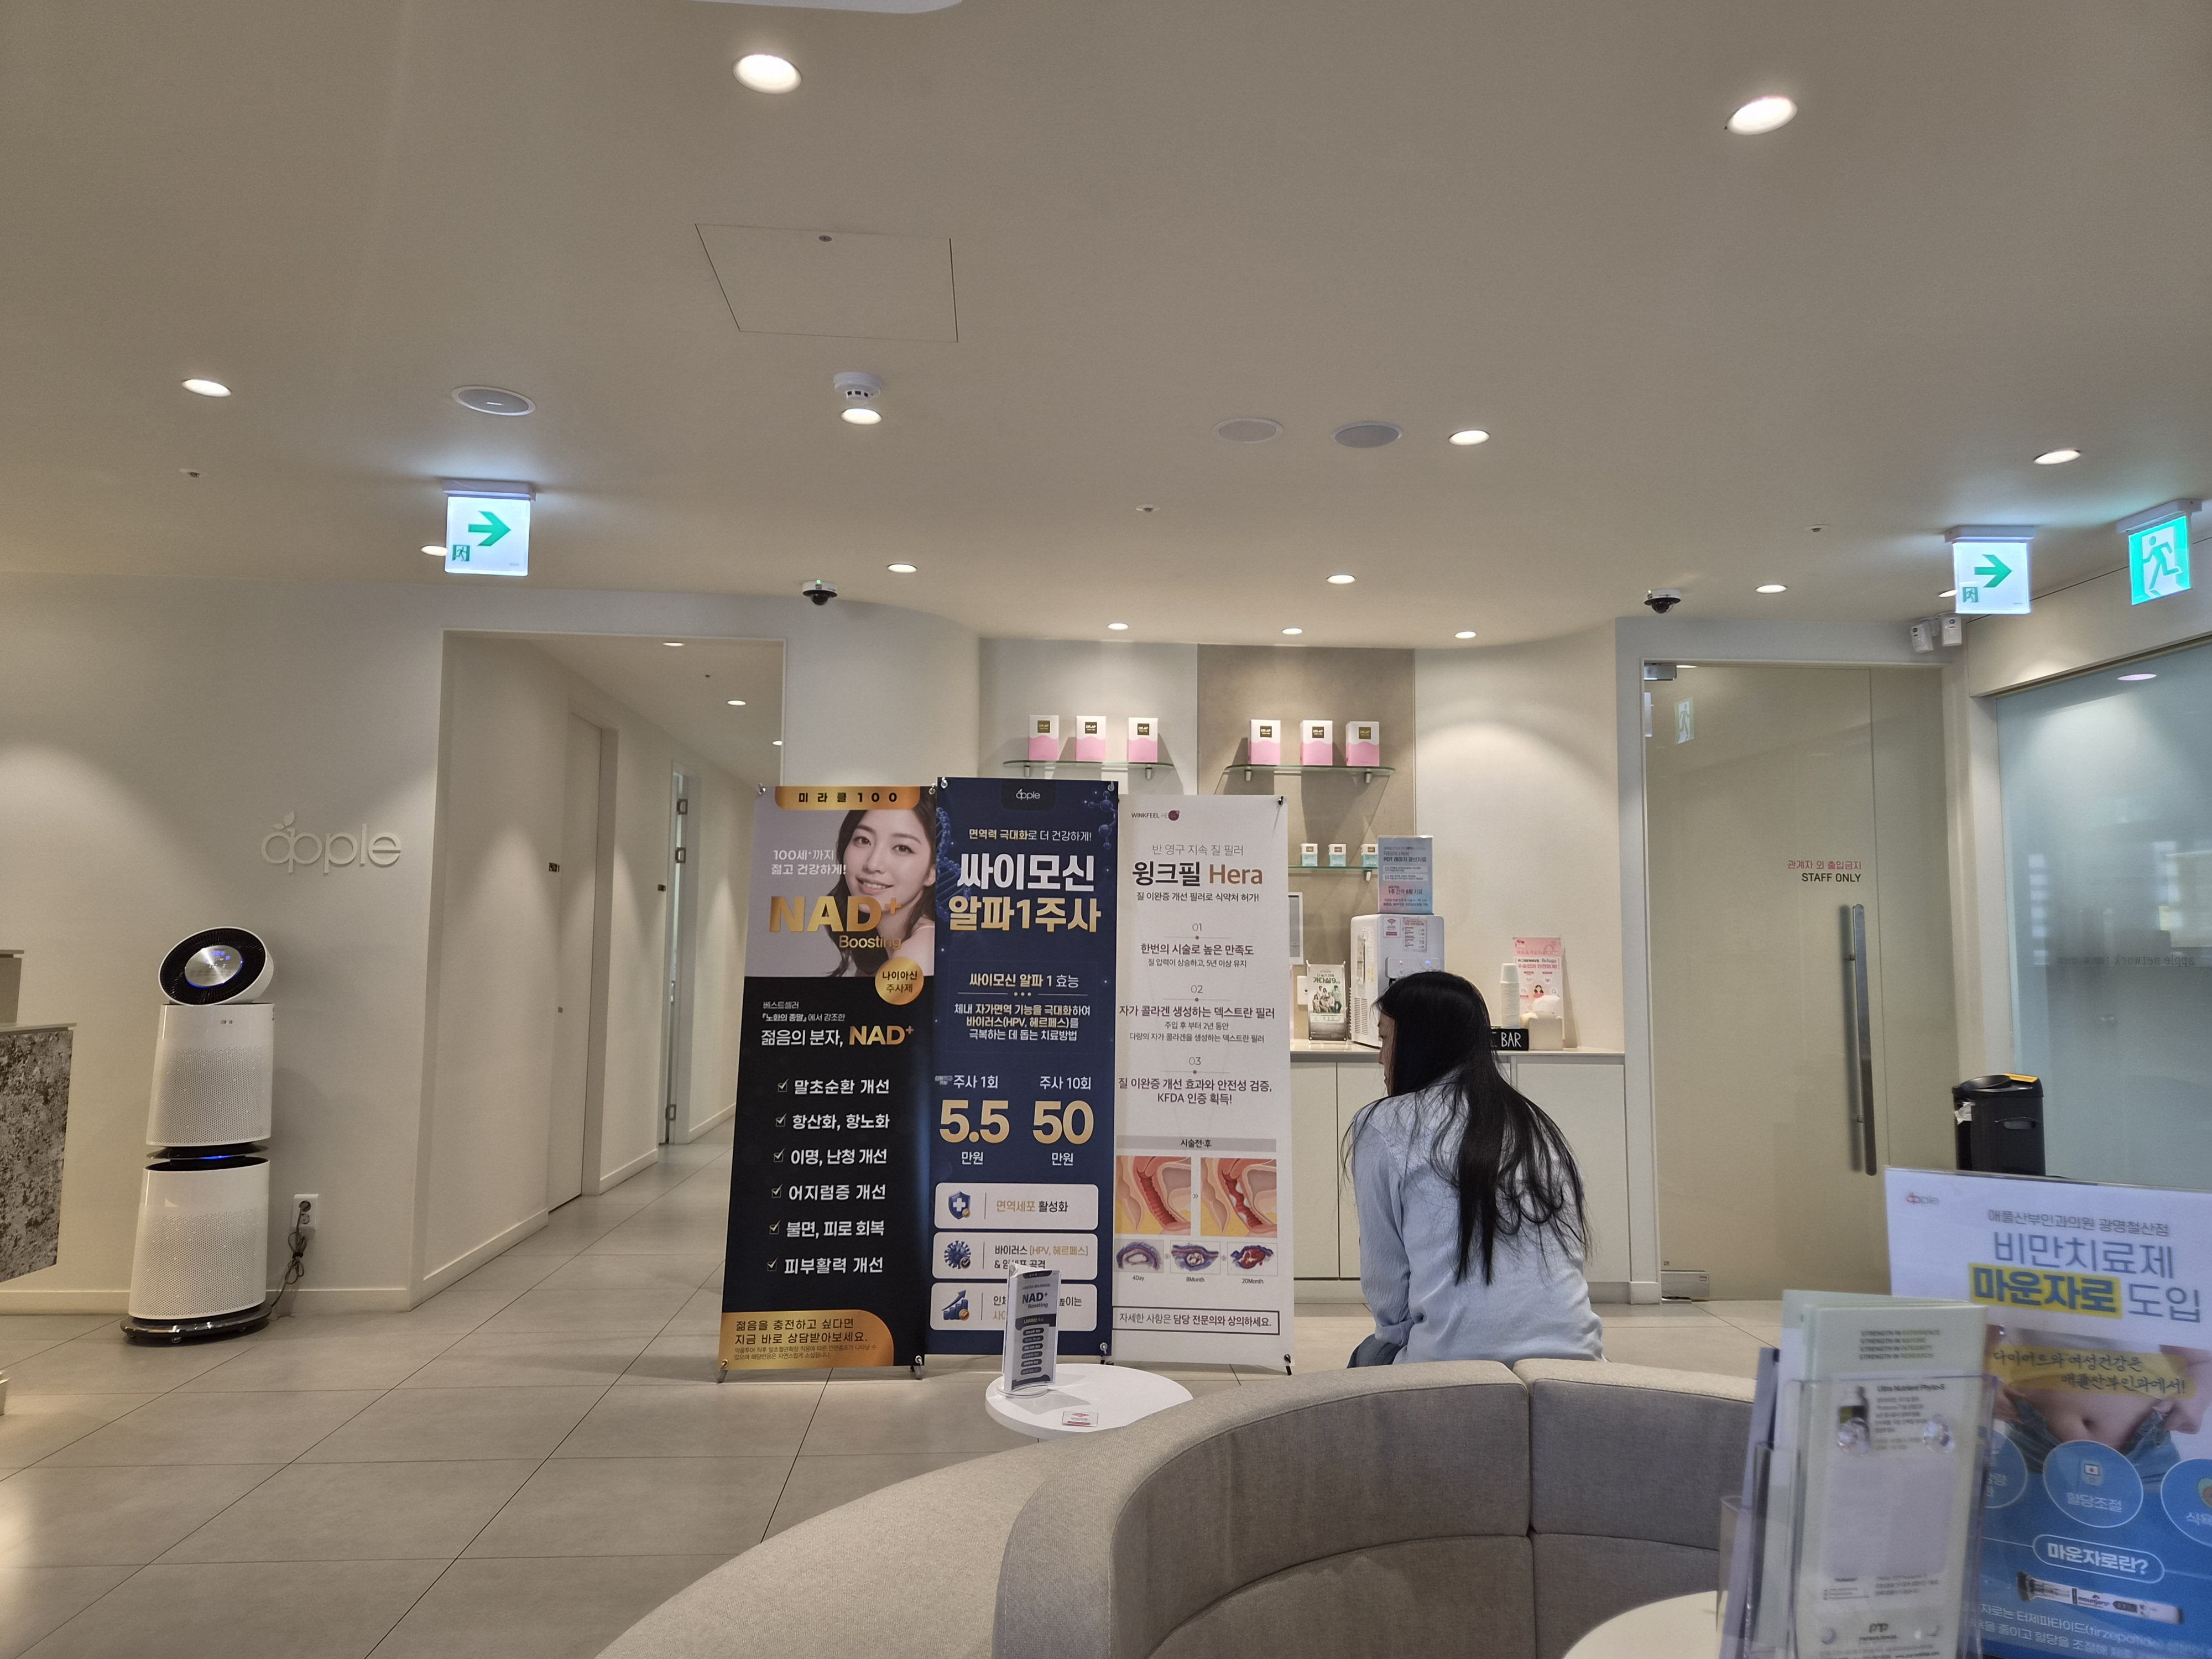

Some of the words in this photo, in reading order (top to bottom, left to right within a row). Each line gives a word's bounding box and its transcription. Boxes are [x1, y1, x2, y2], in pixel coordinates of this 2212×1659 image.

[799, 792, 897, 802] 미라클100
[1016, 789, 1040, 800] apple
[969, 828, 997, 839] 면역력
[1000, 830, 1037, 840] 극대화로
[1040, 831, 1049, 841] 더
[1052, 831, 1091, 841] 건강하게!
[261, 813, 401, 875] apple
[1152, 844, 1161, 854] 반
[1165, 844, 1185, 855] 영구
[1188, 845, 1207, 855] 지속
[1211, 845, 1220, 855] 질
[1224, 845, 1243, 855] 필러
[771, 864, 794, 875] 젊고
[797, 864, 846, 875] 건강하게!
[1787, 860, 1813, 869] 관계자
[1817, 860, 1824, 869] 외
[1827, 861, 1861, 870] 출입금지
[957, 853, 1094, 891] 싸이모신
[1132, 861, 1201, 886] 윙크필
[1209, 864, 1262, 884] Hera
[1802, 873, 1832, 881] STAFF
[1836, 873, 1861, 882] ONLY
[1136, 892, 1144, 900] 질
[1146, 893, 1170, 901] 이완증
[1172, 893, 1187, 901] 개선
[1190, 893, 1213, 901] 필러로
[1215, 893, 1238, 901] 식약처
[1241, 894, 1259, 902] 허가!
[769, 896, 901, 932] NAD+
[949, 896, 1101, 932] 알파1주사
[839, 935, 901, 950] Boosting
[1141, 943, 1169, 954] 한번의
[1172, 944, 1201, 954] 시술로
[1203, 945, 1222, 955] 높은
[1225, 945, 1254, 955] 만족도
[883, 971, 917, 980] 나이아신
[969, 973, 1016, 987] 싸이모신
[1020, 974, 1043, 987] 알파
[1047, 975, 1052, 987] 1
[1056, 974, 1079, 988] 효능
[886, 984, 912, 993] 주사제
[1191, 985, 1203, 993] 02
[763, 1001, 799, 1009] 베스트셀러
[954, 1003, 972, 1014] 체내
[975, 1004, 1012, 1015] 자가면역
[1015, 1004, 1041, 1015] 기능을
[1045, 1005, 1090, 1016] 극대화하여
[824, 1014, 845, 1022] 강조한
[1119, 1006, 1138, 1016] 자가
[1141, 1006, 1170, 1017] 콜라겐
[1173, 1006, 1211, 1018] 생성하는
[1214, 1008, 1253, 1018] 덱스트란
[1255, 1008, 1275, 1019] 필러
[967, 1016, 1027, 1027] 바이러스(HPV,
[1030, 1017, 1078, 1029] 헤르페스)를
[761, 1030, 805, 1046] 젊음의
[810, 1030, 843, 1047] 분자,
[849, 1025, 914, 1046] NAD+
[1501, 1032, 1521, 1047] BAR
[1189, 1057, 1201, 1065] 03
[795, 1079, 854, 1095] 말초순환
[860, 1079, 889, 1094] 개선
[953, 1075, 978, 1088] 주사
[980, 1076, 998, 1088] 1회
[1040, 1076, 1063, 1089] 주사
[1067, 1077, 1091, 1090] 10회
[1118, 1078, 1127, 1089] 질
[1131, 1078, 1160, 1089] 이완증
[1163, 1079, 1182, 1090] 개선
[1185, 1079, 1214, 1091] 효과와
[1218, 1080, 1246, 1091] 안전성
[1250, 1080, 1272, 1092] 검증,
[1157, 1093, 1184, 1103] KFDA
[1187, 1093, 1207, 1104] 인증
[1209, 1094, 1232, 1105] 획득!
[792, 1114, 840, 1131] 항산화,
[846, 1114, 890, 1129] 항노화
[940, 1099, 1010, 1144] 5.5
[1033, 1100, 1094, 1144] 50
[961, 1151, 983, 1165] 만원
[1906, 1192, 1939, 1205] apple
[997, 1201, 1035, 1212] 면역세포
[1038, 1201, 1068, 1212] 활성화
[786, 1222, 819, 1239] 불면,
[823, 1221, 852, 1237] 피로
[856, 1220, 884, 1236] 회복
[1988, 1210, 2095, 1230] 애플산부인과의원
[2099, 1218, 2169, 1237] 광명철산점
[995, 1245, 1027, 1255] 바이러스
[1030, 1246, 1051, 1256] [HPV,
[1053, 1245, 1088, 1256] 헤르페스]
[1994, 1232, 2174, 1279] 비만치료제
[1030, 1260, 1045, 1269] 공격
[1022, 1292, 1048, 1303] NAD+
[1973, 1267, 2116, 1312] 마운자로
[2128, 1284, 2201, 1323] 도입
[736, 1320, 768, 1332] 젊음을
[773, 1319, 817, 1331] 충전하고
[822, 1318, 854, 1329] 싶다면
[1119, 1313, 1144, 1323] 자세한
[1146, 1314, 1171, 1324] 사항은
[1173, 1315, 1190, 1325] 담당
[1192, 1316, 1225, 1326] 전문의와
[1228, 1317, 1271, 1327] 상의하세요.
[735, 1334, 756, 1345] 지금
[762, 1334, 782, 1344] 바로
[788, 1332, 868, 1343] 상담받아보세요.
[1993, 1350, 2065, 1369] 다이어트와
[2068, 1354, 2143, 1372] 여성건강은
[2067, 1493, 2122, 1512] 혈당조절
[2047, 1542, 2148, 1575] 마운자로란?
